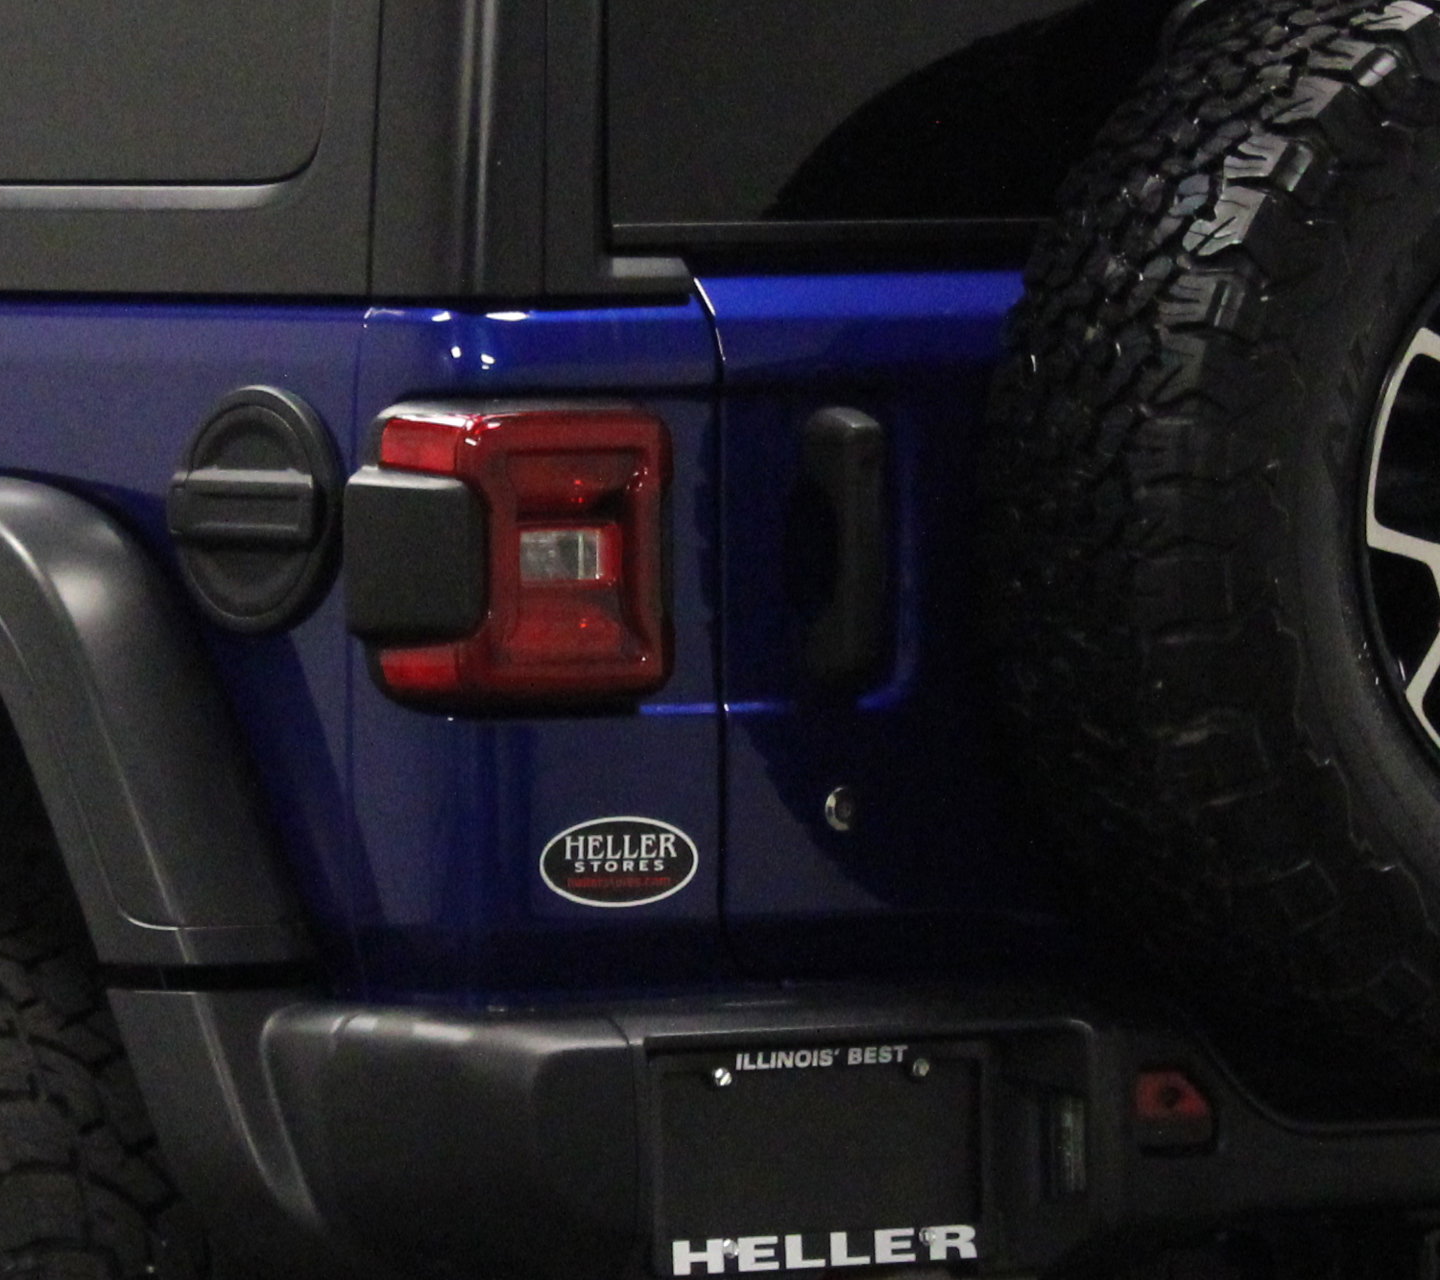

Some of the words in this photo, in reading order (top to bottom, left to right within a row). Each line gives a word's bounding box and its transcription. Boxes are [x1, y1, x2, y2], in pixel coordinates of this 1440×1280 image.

[564, 833, 678, 860] HELLER
[574, 860, 665, 873] STORES
[847, 1045, 908, 1066] BEST
[672, 1224, 978, 1276] HELLER
